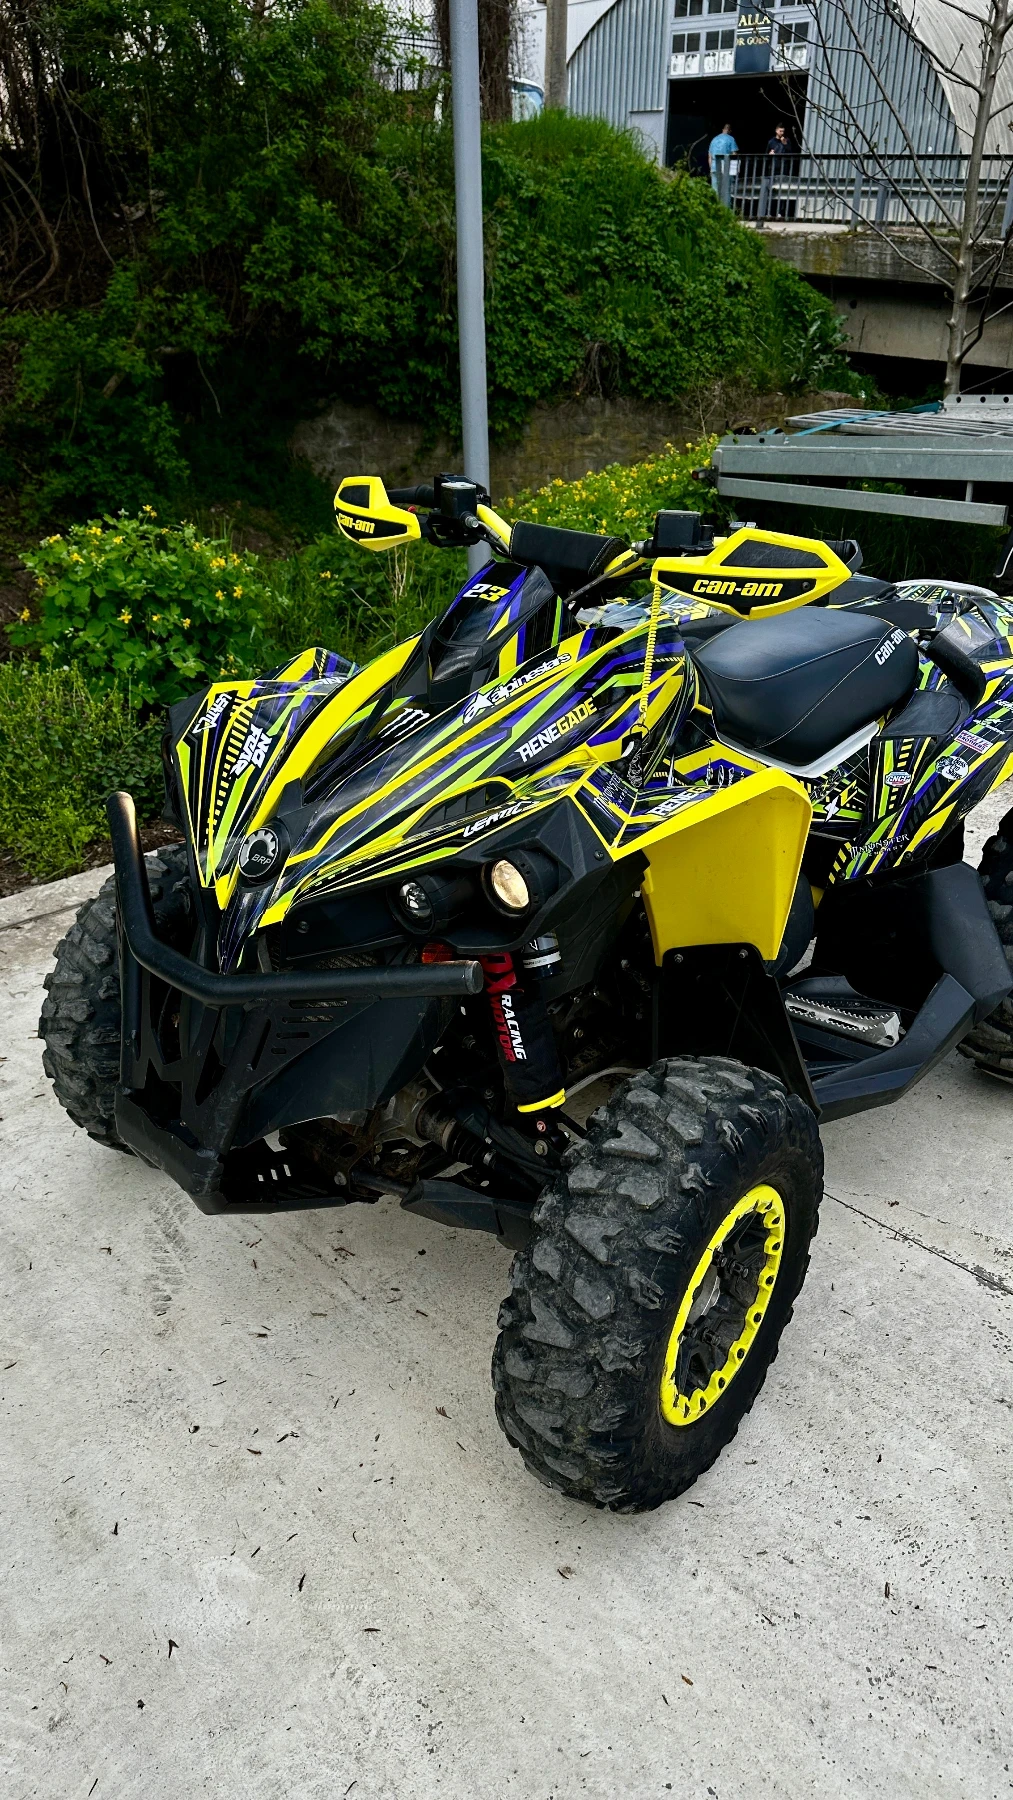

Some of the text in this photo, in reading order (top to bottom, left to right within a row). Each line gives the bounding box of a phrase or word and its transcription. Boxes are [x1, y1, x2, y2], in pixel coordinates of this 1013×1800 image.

[462, 583, 512, 603] 23
[692, 578, 784, 597] can-am
[874, 628, 908, 666] can-am
[489, 652, 573, 704] alpinestars
[514, 697, 598, 763] RENEGADE
[230, 723, 264, 780] FEAR
[252, 733, 273, 769] NO
[646, 785, 711, 816] RENEG
[250, 853, 272, 866] BRP
[490, 995, 517, 1062] MOTOR
[501, 994, 527, 1060] RACING
